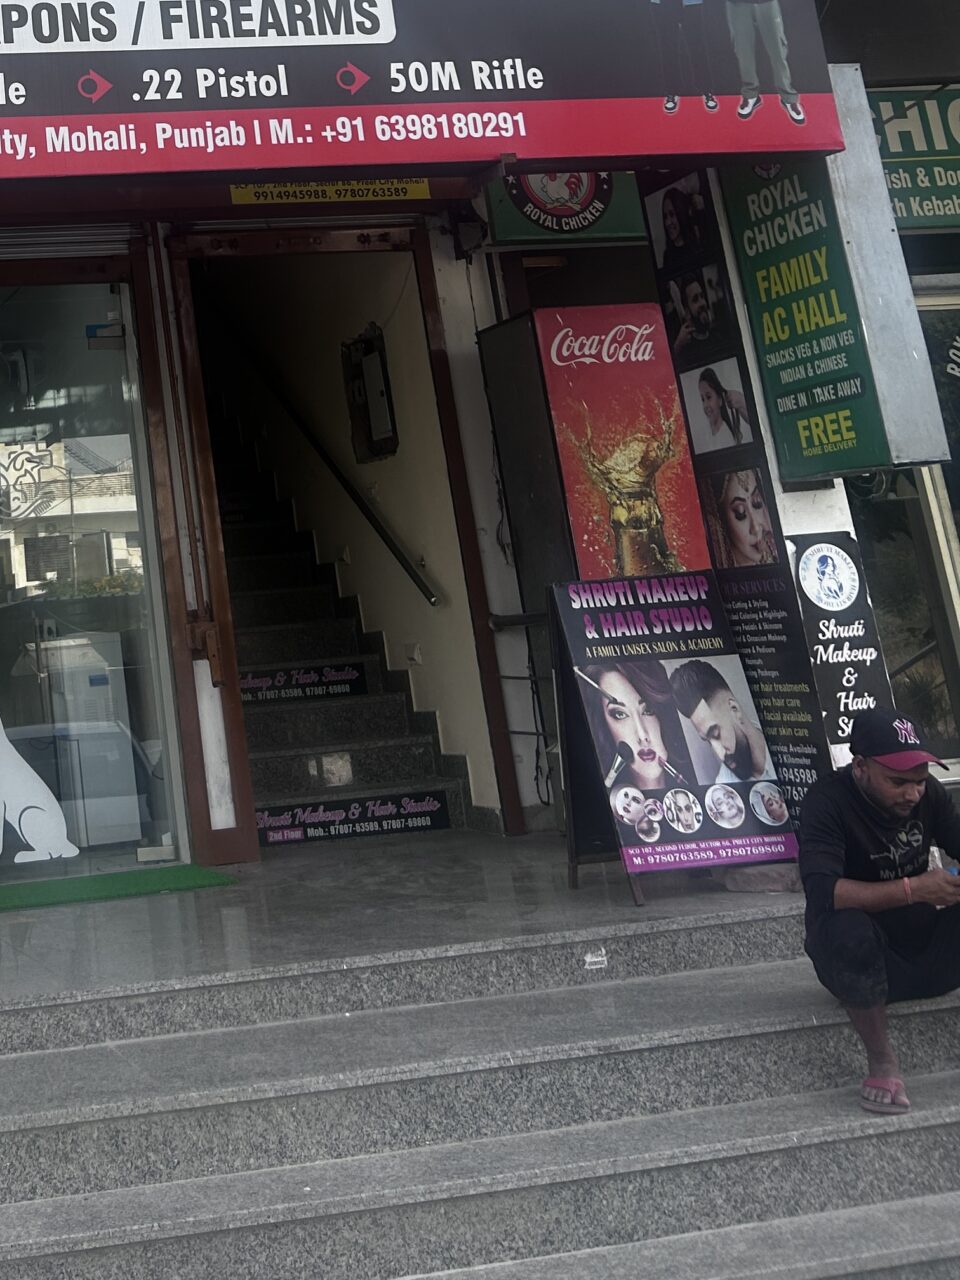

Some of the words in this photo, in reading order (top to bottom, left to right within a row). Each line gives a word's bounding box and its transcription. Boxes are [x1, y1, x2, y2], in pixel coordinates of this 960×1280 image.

[132, 68, 184, 102] .22
[195, 64, 289, 100] Pistol
[389, 61, 461, 94] 50M
[472, 58, 545, 92] Rifle
[45, 123, 147, 155] Mohali,
[156, 119, 246, 153] Punjab
[321, 116, 366, 144] +91
[375, 111, 527, 142] 6398180291
[916, 167, 931, 188] &
[254, 189, 332, 201] 9914945988,
[335, 187, 409, 199] 9780763589
[746, 174, 808, 222] ROYAL
[523, 202, 560, 231] ROYAL
[561, 199, 605, 231] CHICKEN
[743, 199, 828, 257] CHICKEN
[755, 245, 829, 303] FAMILY
[761, 306, 790, 346] AC
[791, 288, 848, 336] HALL
[765, 348, 796, 368] SNACKS
[796, 342, 812, 360] VEG
[812, 340, 821, 355] &
[820, 335, 836, 352] NON
[838, 329, 855, 347] VEG
[779, 365, 807, 385] INDIAN
[807, 362, 814, 378] &
[815, 352, 849, 375] CHINESE
[776, 395, 797, 413] DINE
[797, 389, 808, 408] IN
[812, 385, 836, 404] TAKE
[837, 377, 862, 399] AWAY
[796, 409, 856, 449] FREE
[802, 445, 823, 457] HOME
[823, 438, 858, 454] DELIVERY
[568, 581, 635, 609] SHRUTI
[634, 575, 709, 605] MAKEUP
[583, 613, 600, 639] &
[599, 610, 650, 639] HAIR
[649, 605, 713, 635] STUDIO
[818, 619, 866, 640] Shruti
[585, 647, 592, 659] A
[592, 644, 621, 659] FAMILY
[622, 642, 652, 657] UNISEX
[653, 640, 679, 654] SALON
[681, 639, 687, 652] &
[688, 637, 725, 651] ACADEMY
[813, 642, 878, 666] Makeup
[760, 682, 773, 693] hair
[773, 681, 810, 693] treatments
[842, 667, 858, 687] &
[772, 697, 785, 708] hair
[786, 697, 801, 708] care
[837, 691, 877, 712] Hair
[779, 725, 793, 737] skin
[794, 726, 809, 738] care
[268, 830, 283, 842] 2nd
[647, 850, 718, 865] 9780763589,
[719, 844, 785, 857] 9780769860
